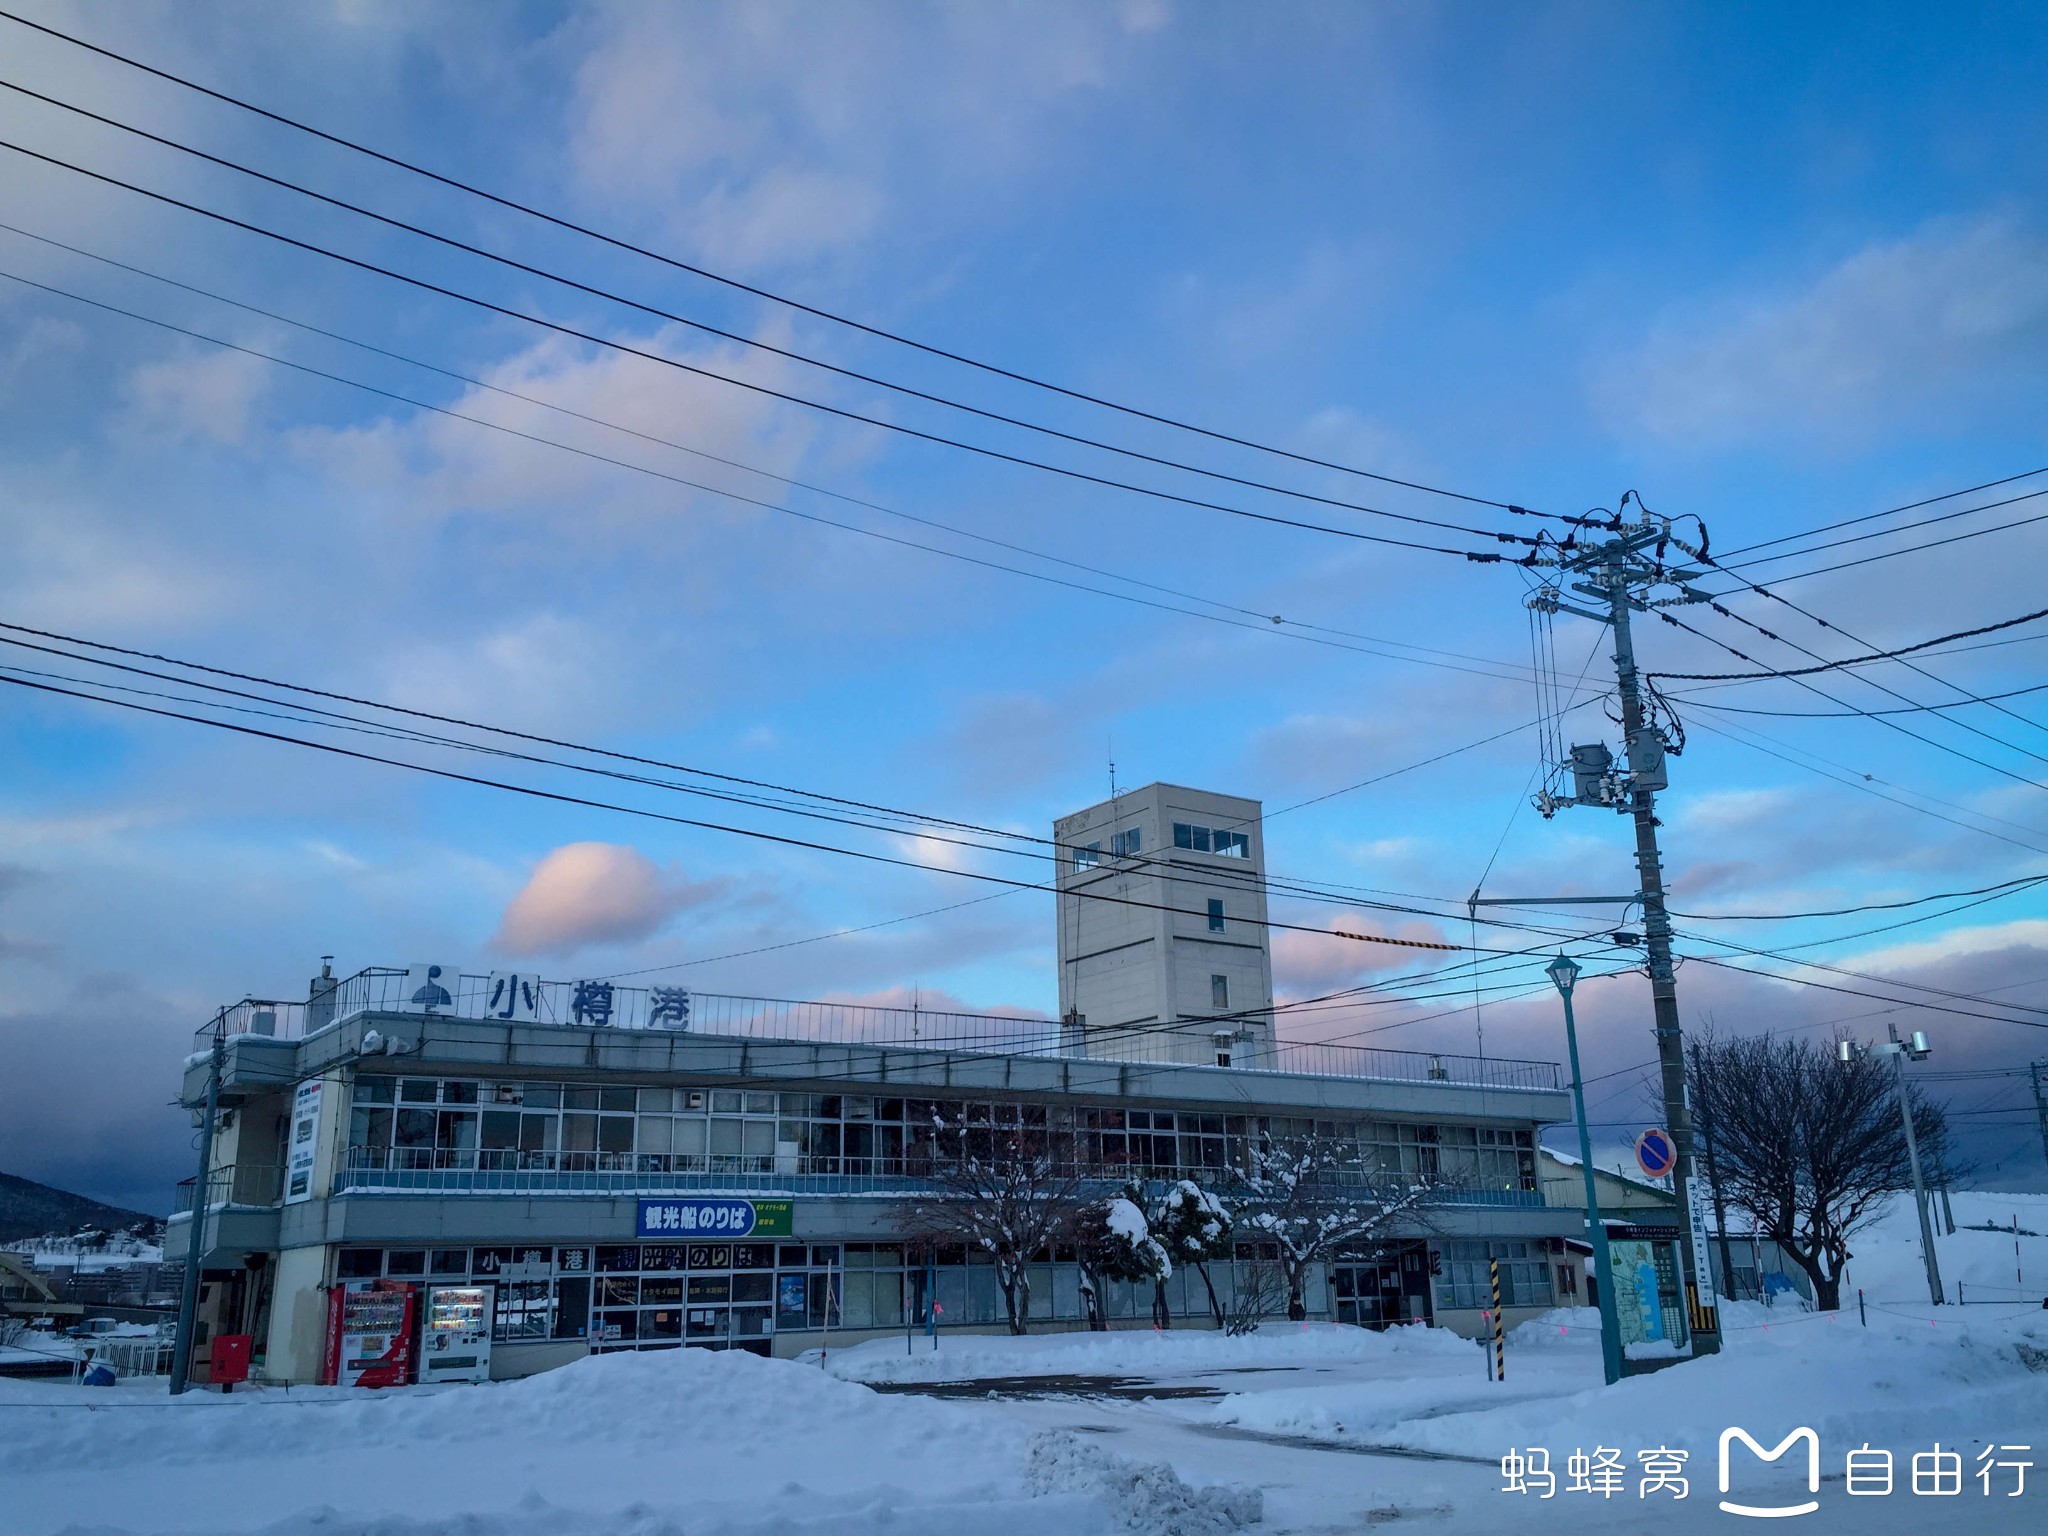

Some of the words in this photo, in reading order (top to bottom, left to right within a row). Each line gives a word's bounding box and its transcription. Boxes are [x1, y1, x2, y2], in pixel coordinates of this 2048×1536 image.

[490, 973, 690, 1031] 小樽港
[645, 1206, 747, 1230] 観光船のりば
